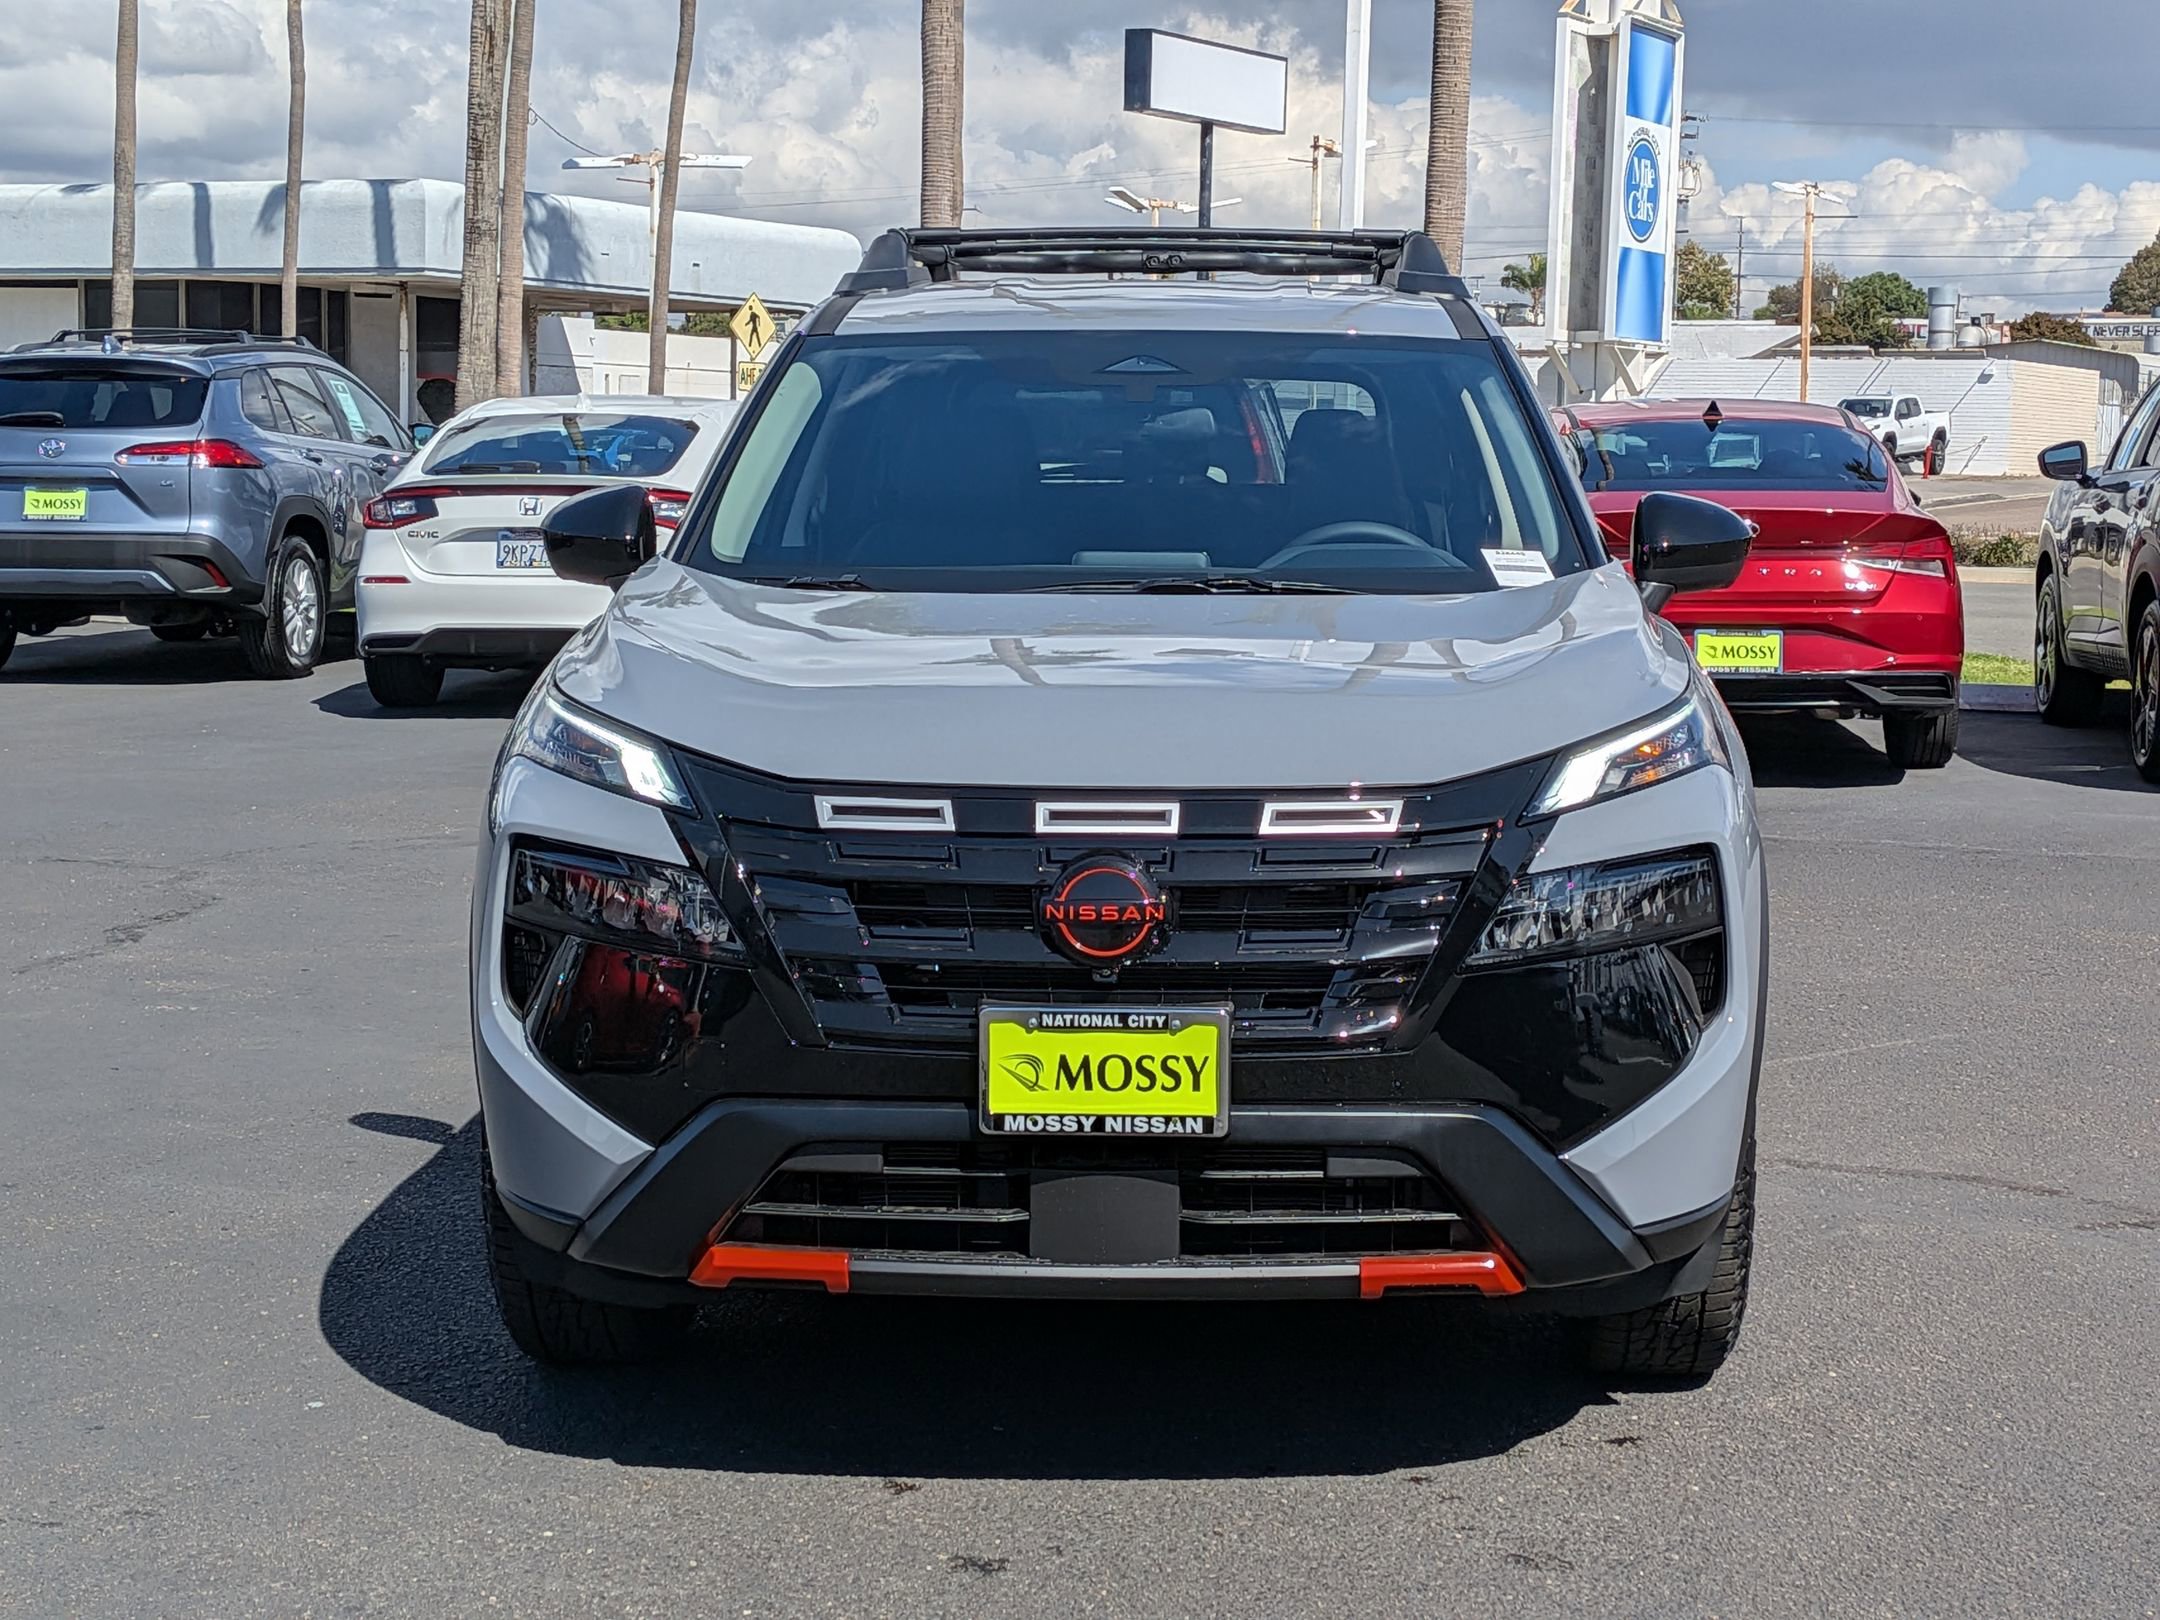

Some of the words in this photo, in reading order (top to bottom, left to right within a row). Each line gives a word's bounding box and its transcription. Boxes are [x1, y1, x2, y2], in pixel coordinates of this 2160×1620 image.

[1631, 156, 1655, 188] Mile
[1628, 190, 1654, 223] Cars
[2092, 325, 2130, 337] NEVER
[41, 498, 83, 510] MOSSY
[407, 530, 440, 539] CIVIC
[1721, 645, 1777, 660] MOSSY
[1045, 903, 1166, 921] NISSAN
[1041, 1013, 1123, 1028] NATIONAL
[1127, 1014, 1168, 1029] CITY
[1054, 1053, 1210, 1093] MOSSY
[1003, 1114, 1098, 1133] MOSSY
[1104, 1116, 1204, 1134] NISSAN
